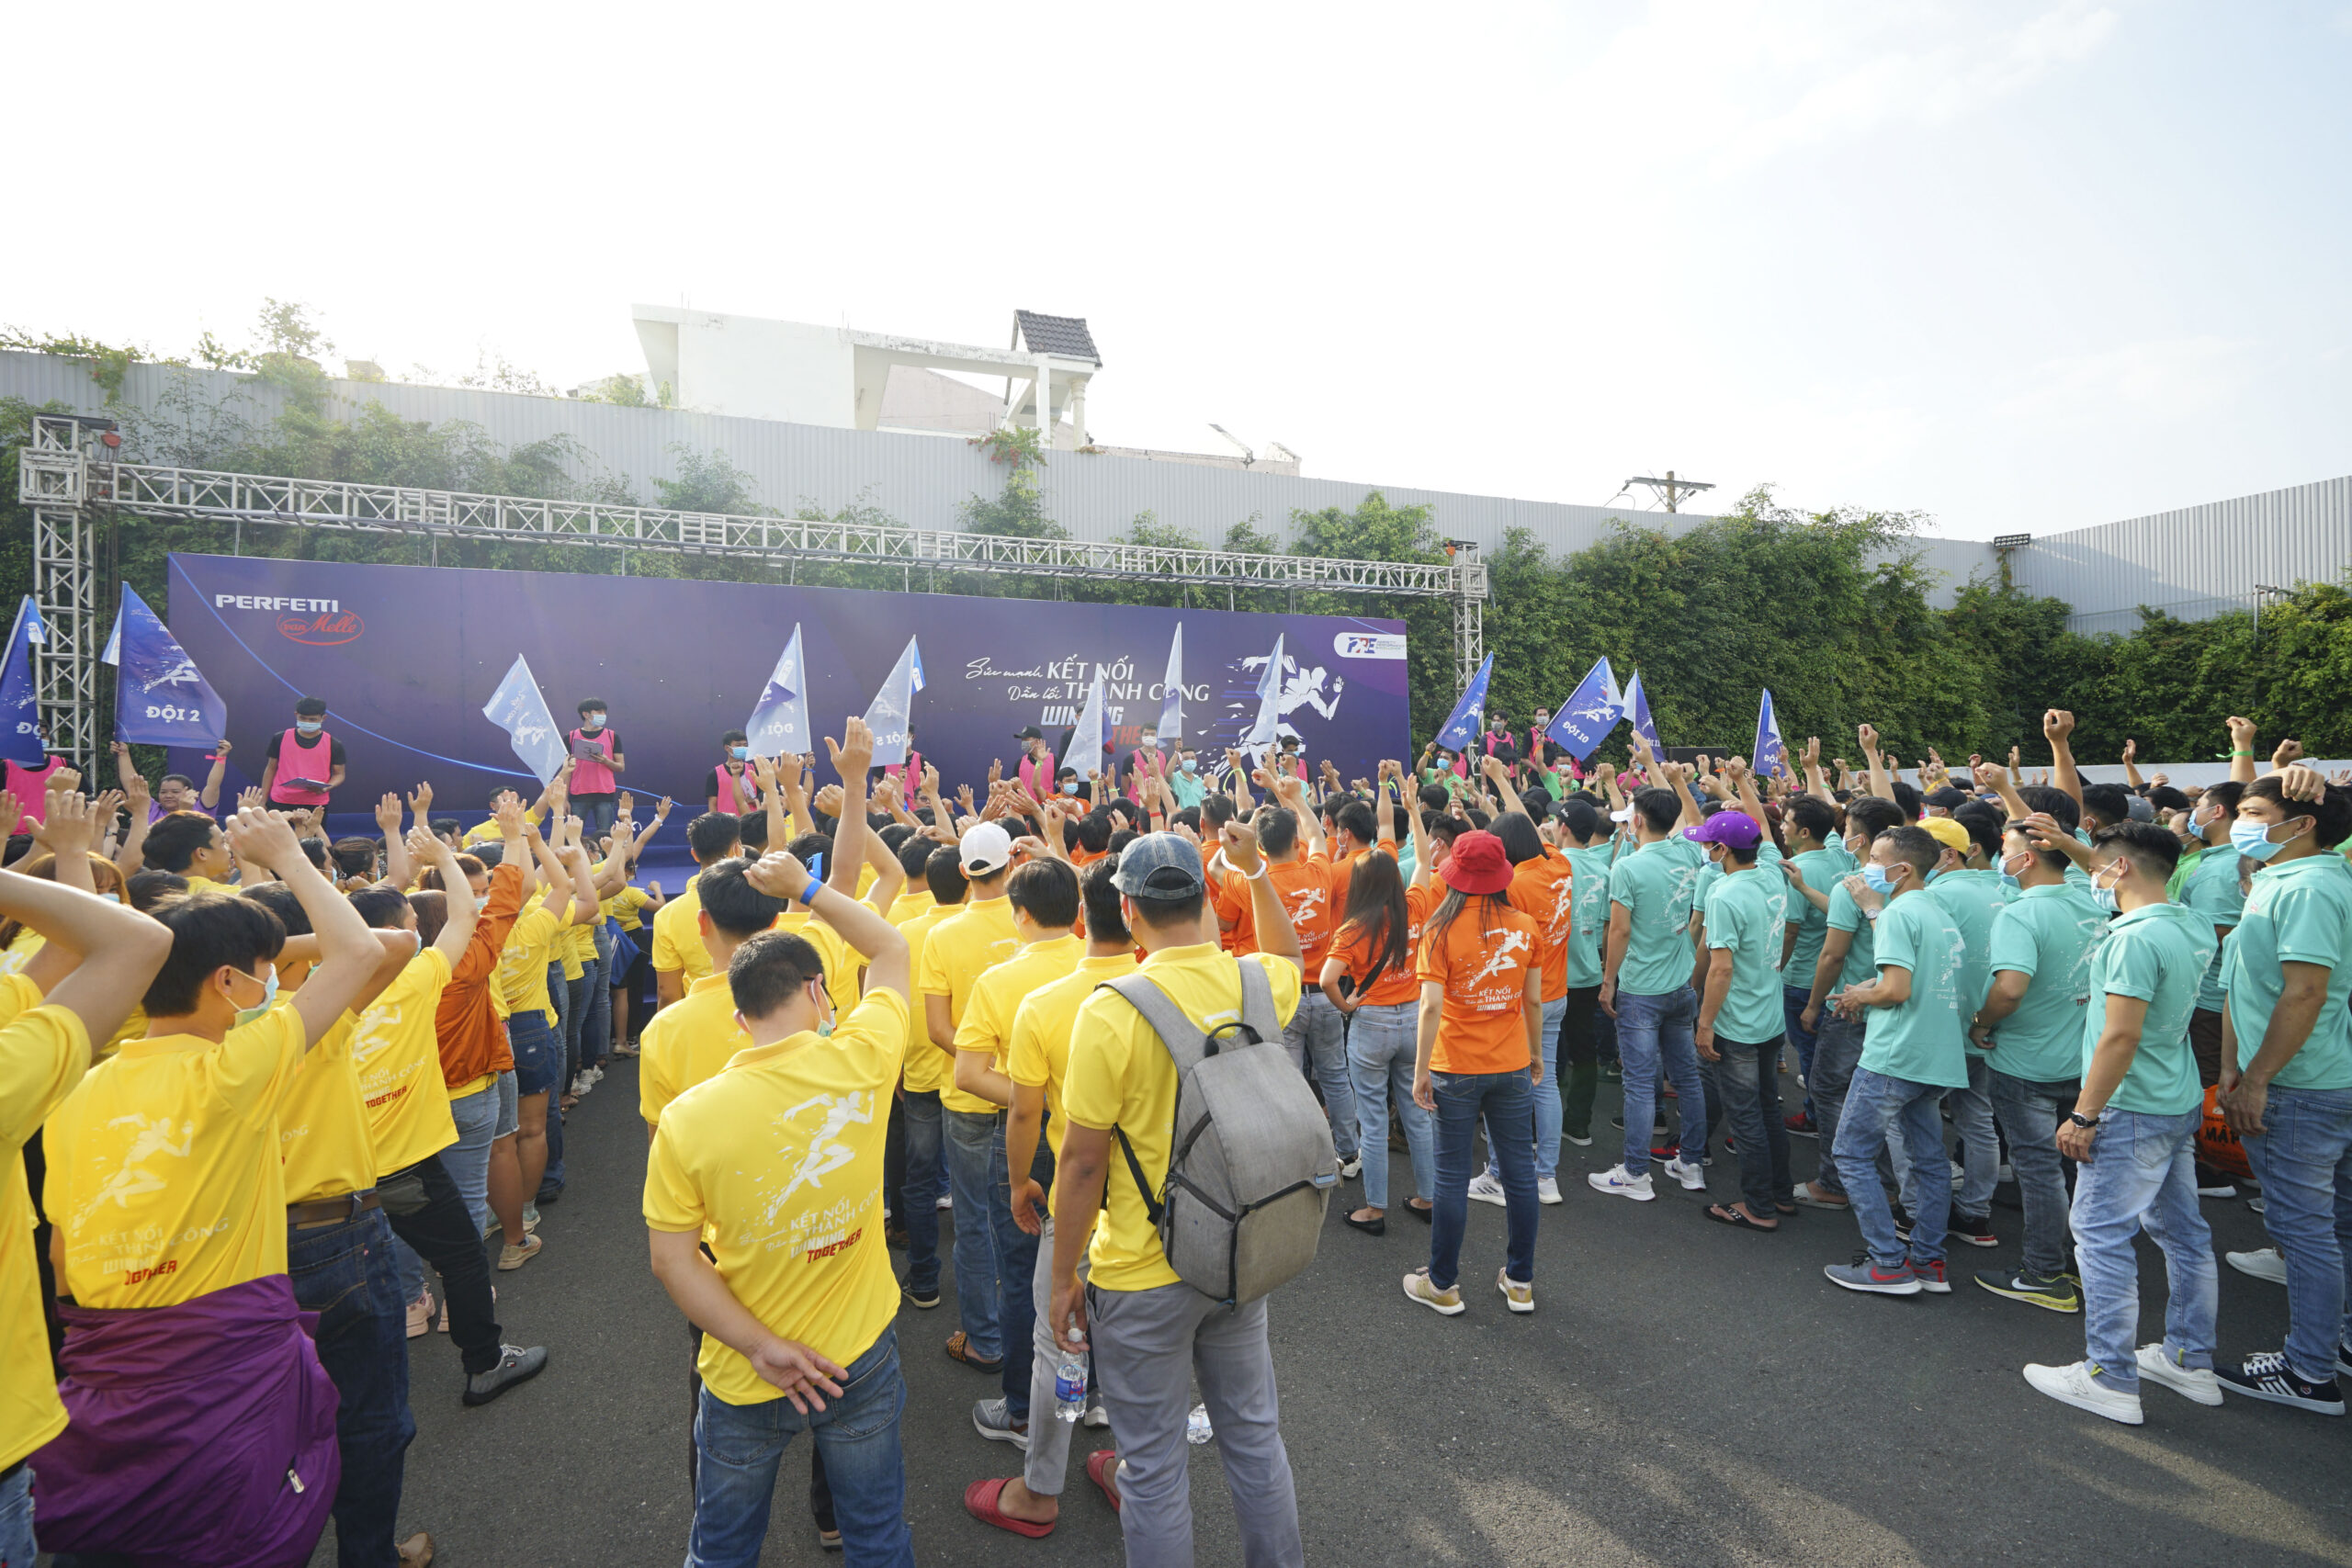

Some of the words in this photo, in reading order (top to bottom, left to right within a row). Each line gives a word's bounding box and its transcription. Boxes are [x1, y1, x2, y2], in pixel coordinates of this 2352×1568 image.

[215, 593, 338, 614] PERFETTI
[311, 612, 357, 634] Melle
[1046, 653, 1089, 680] KẾT
[1096, 655, 1134, 681] NỐI
[1065, 682, 1143, 701] THNH
[1148, 682, 1210, 702] CNG
[145, 704, 186, 723] ĐỘI
[188, 709, 200, 722] 2
[1562, 720, 1580, 737] ĐỘI
[1577, 732, 1589, 743] 10
[365, 1085, 408, 1109] TOGETHER
[790, 1209, 819, 1231] KẾT
[822, 1195, 851, 1221] NỐI
[805, 1207, 856, 1237] THÀNH
[168, 1217, 229, 1247] CÔNG
[790, 1227, 846, 1259] WINNING
[807, 1227, 863, 1264] TOGETHER
